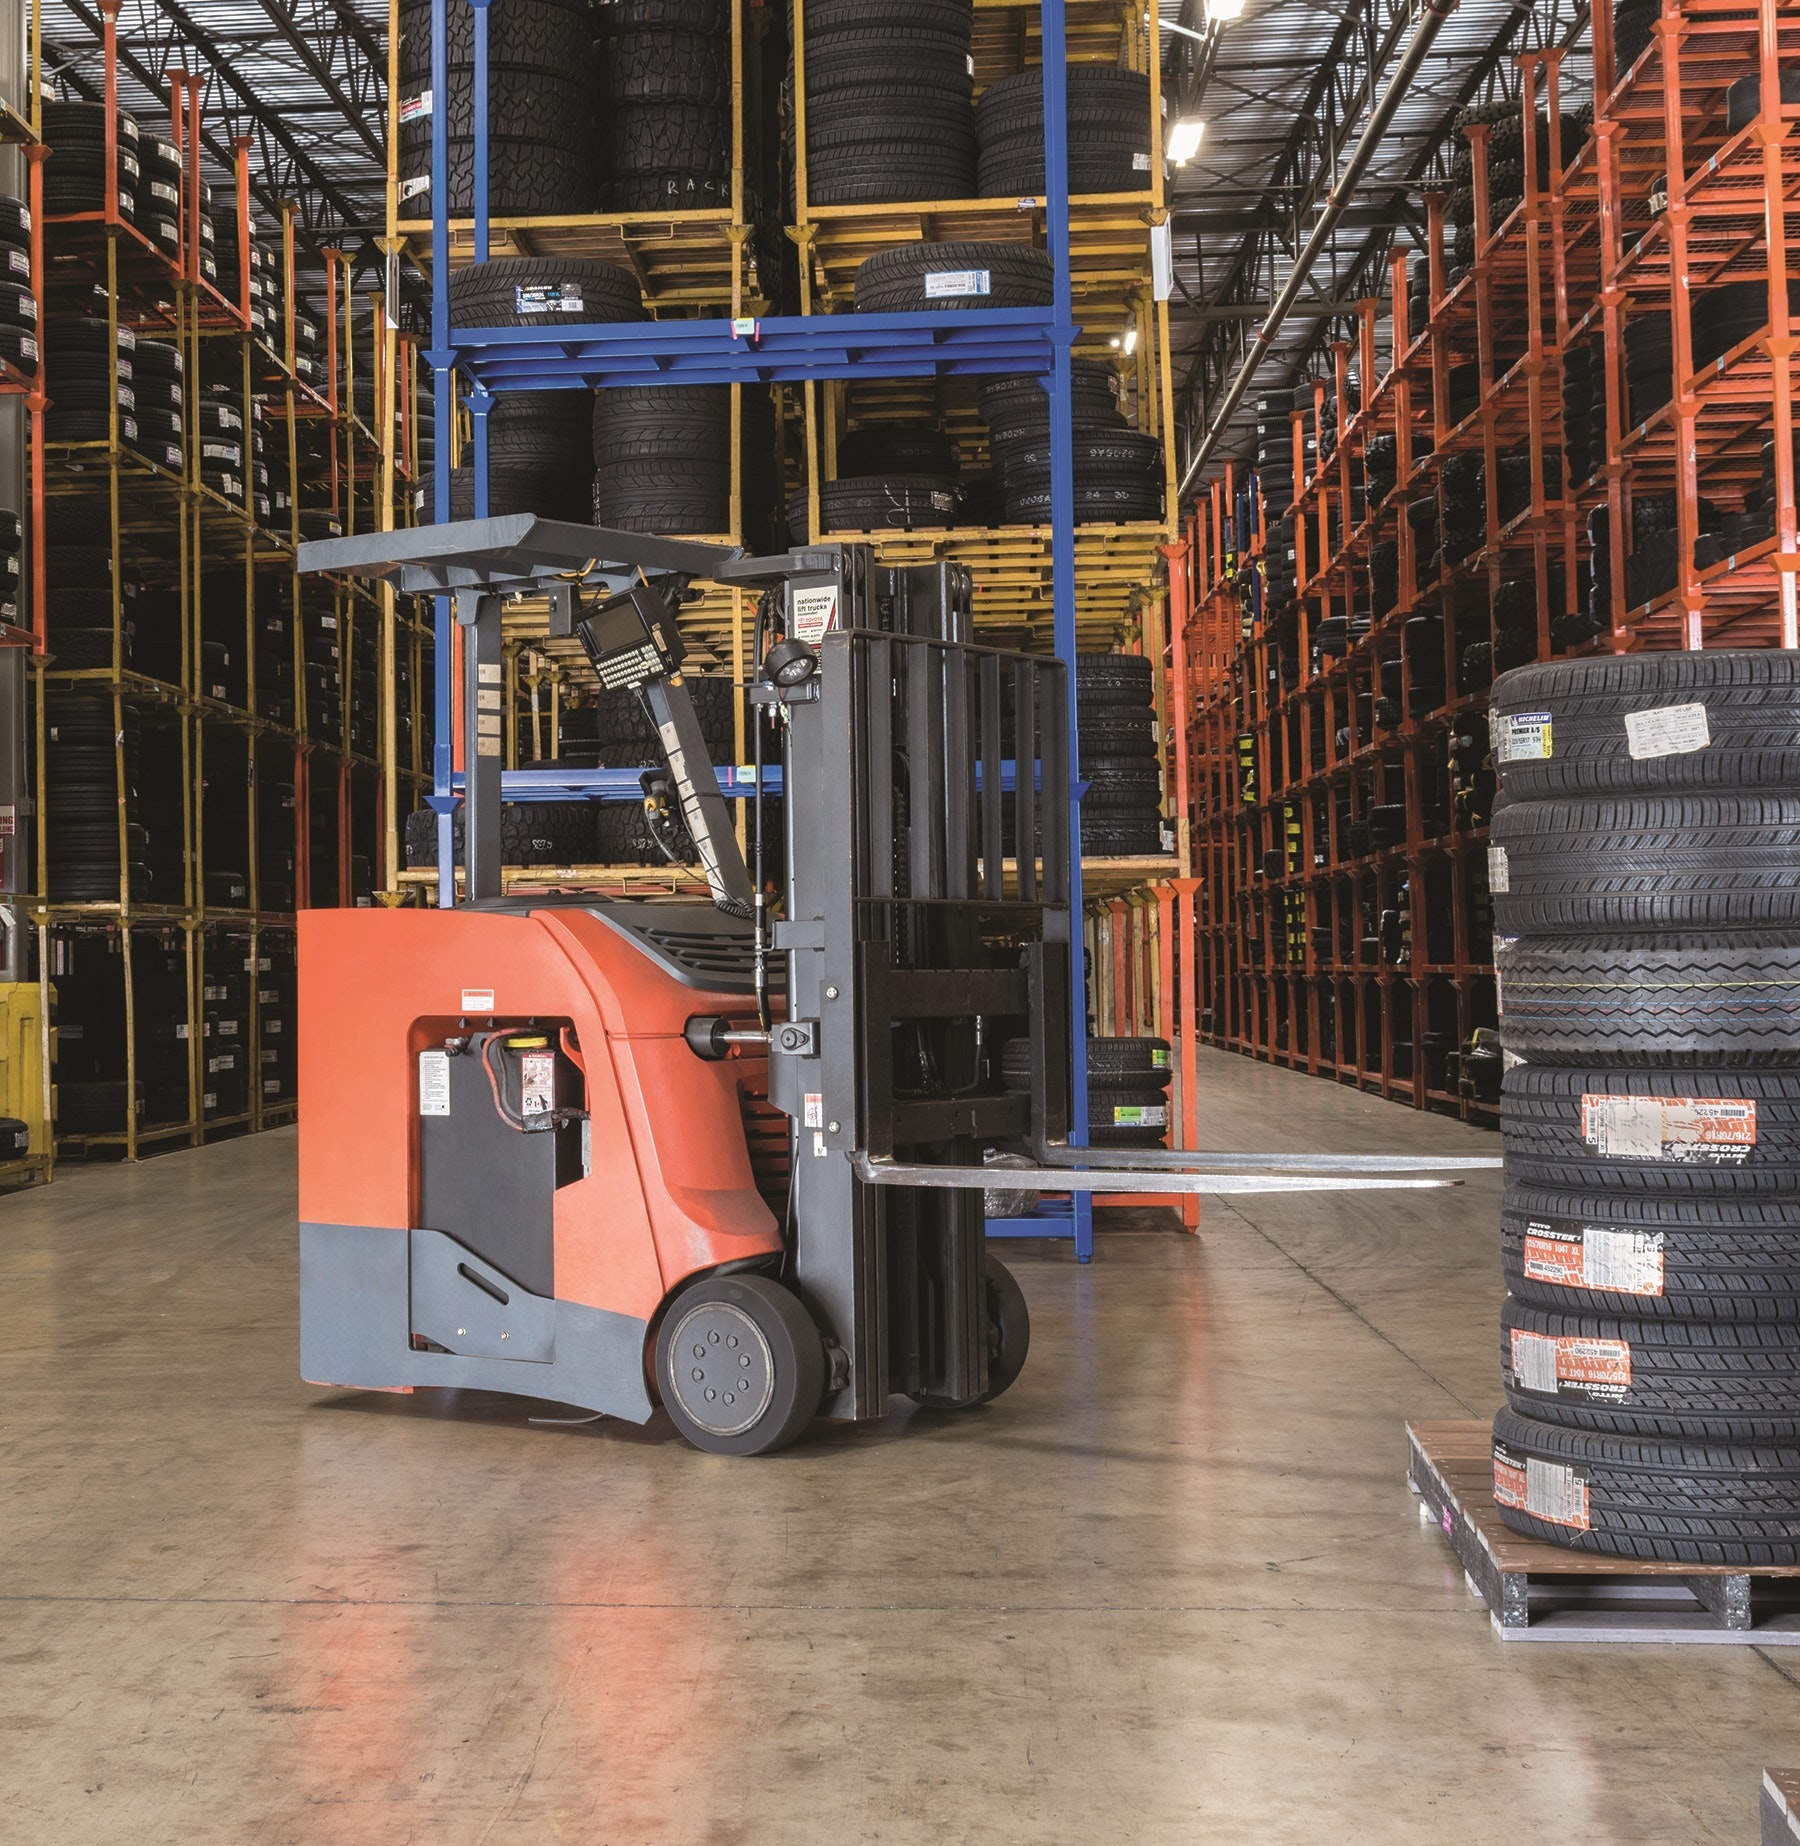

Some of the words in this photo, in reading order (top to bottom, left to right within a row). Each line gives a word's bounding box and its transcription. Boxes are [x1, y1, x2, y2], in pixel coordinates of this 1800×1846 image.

[668, 178, 728, 197] RACK
[797, 596, 831, 605] nationwide
[1512, 727, 1529, 735] PREMIER
[1529, 1222, 1551, 1230] NITTO
[1555, 1244, 1569, 1253] 104T
[1571, 1246, 1580, 1255] XL
[1574, 1348, 1598, 1356] 452290
[1558, 1367, 1567, 1376] XL
[1569, 1368, 1585, 1378] 104T
[1587, 1369, 1627, 1382] 215/70R16
